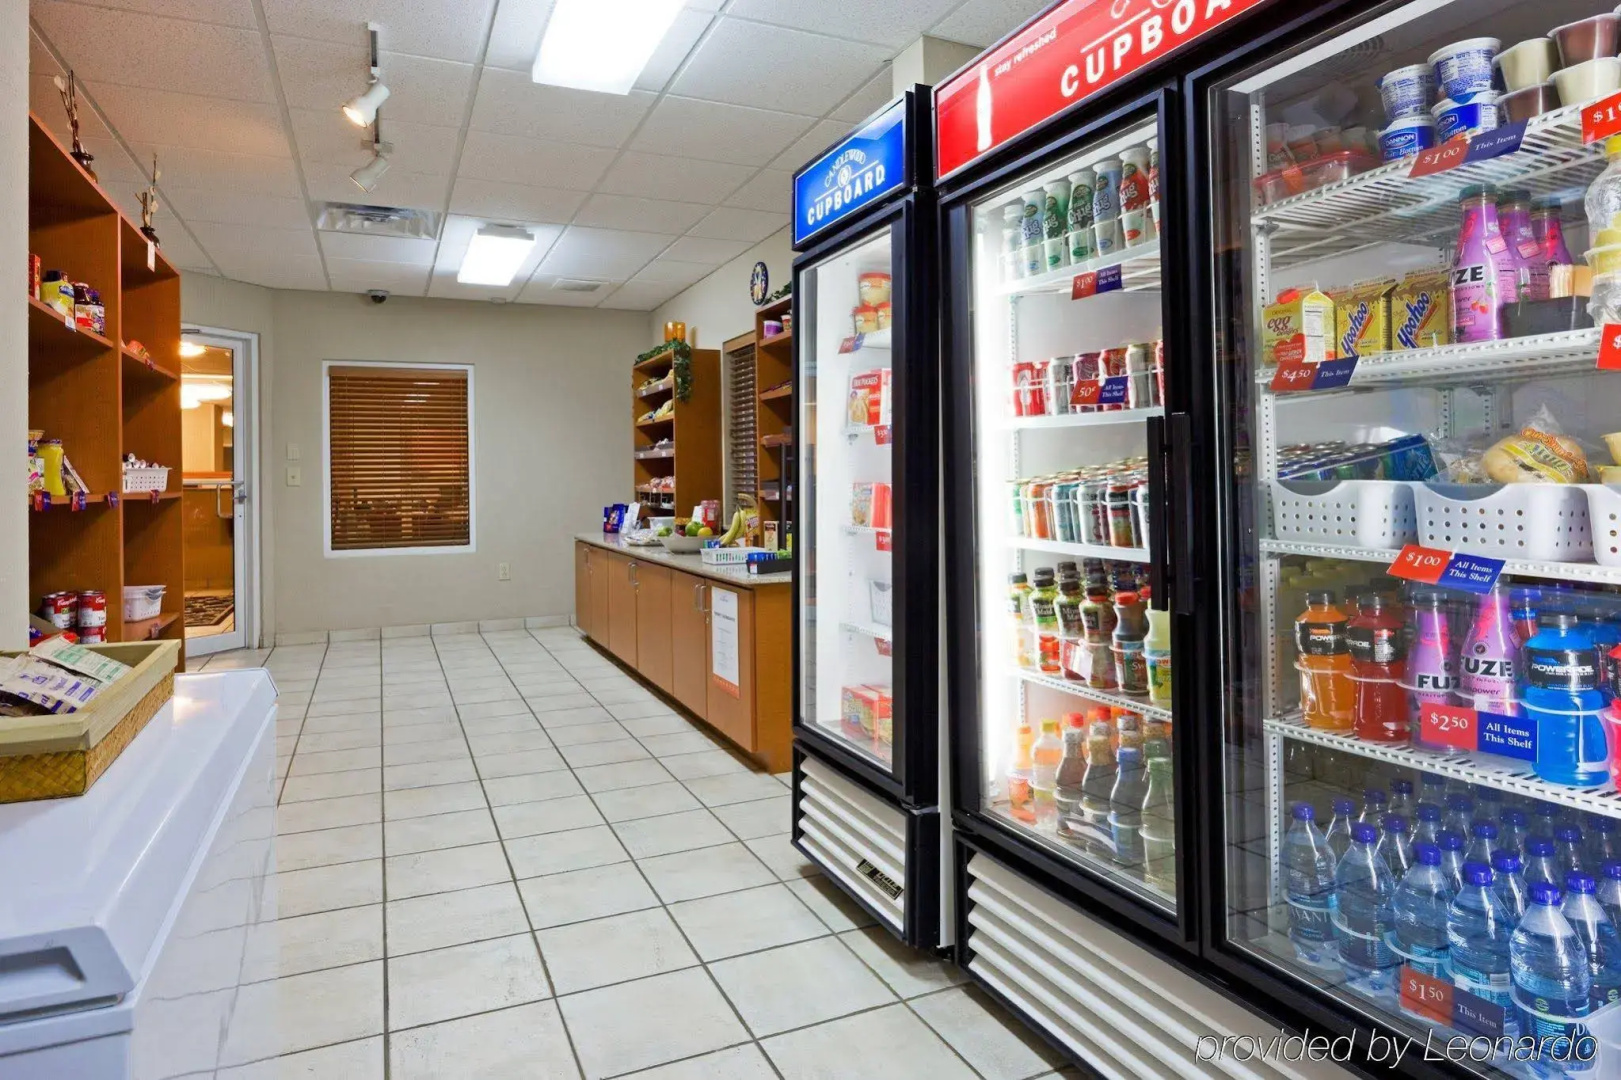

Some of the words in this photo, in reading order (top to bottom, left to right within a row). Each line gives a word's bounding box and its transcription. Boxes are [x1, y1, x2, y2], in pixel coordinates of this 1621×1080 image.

[994, 60, 1012, 77] stay
[1013, 25, 1057, 64] refreshed
[1384, 133, 1415, 147] DANNON
[1475, 142, 1494, 151] This
[807, 164, 886, 226] CUPBOARD
[1267, 315, 1292, 333] egg
[1455, 560, 1468, 569] All
[1470, 563, 1493, 573] Items
[1449, 568, 1467, 579] This
[1469, 572, 1492, 583] Shelf
[1531, 663, 1594, 674] POWERADE
[1486, 722, 1501, 732] All
[1503, 724, 1530, 738] Items
[1483, 732, 1505, 744] This
[1507, 736, 1533, 750] Shelf
[1457, 1003, 1476, 1019] This
[1479, 1012, 1497, 1029] Item
